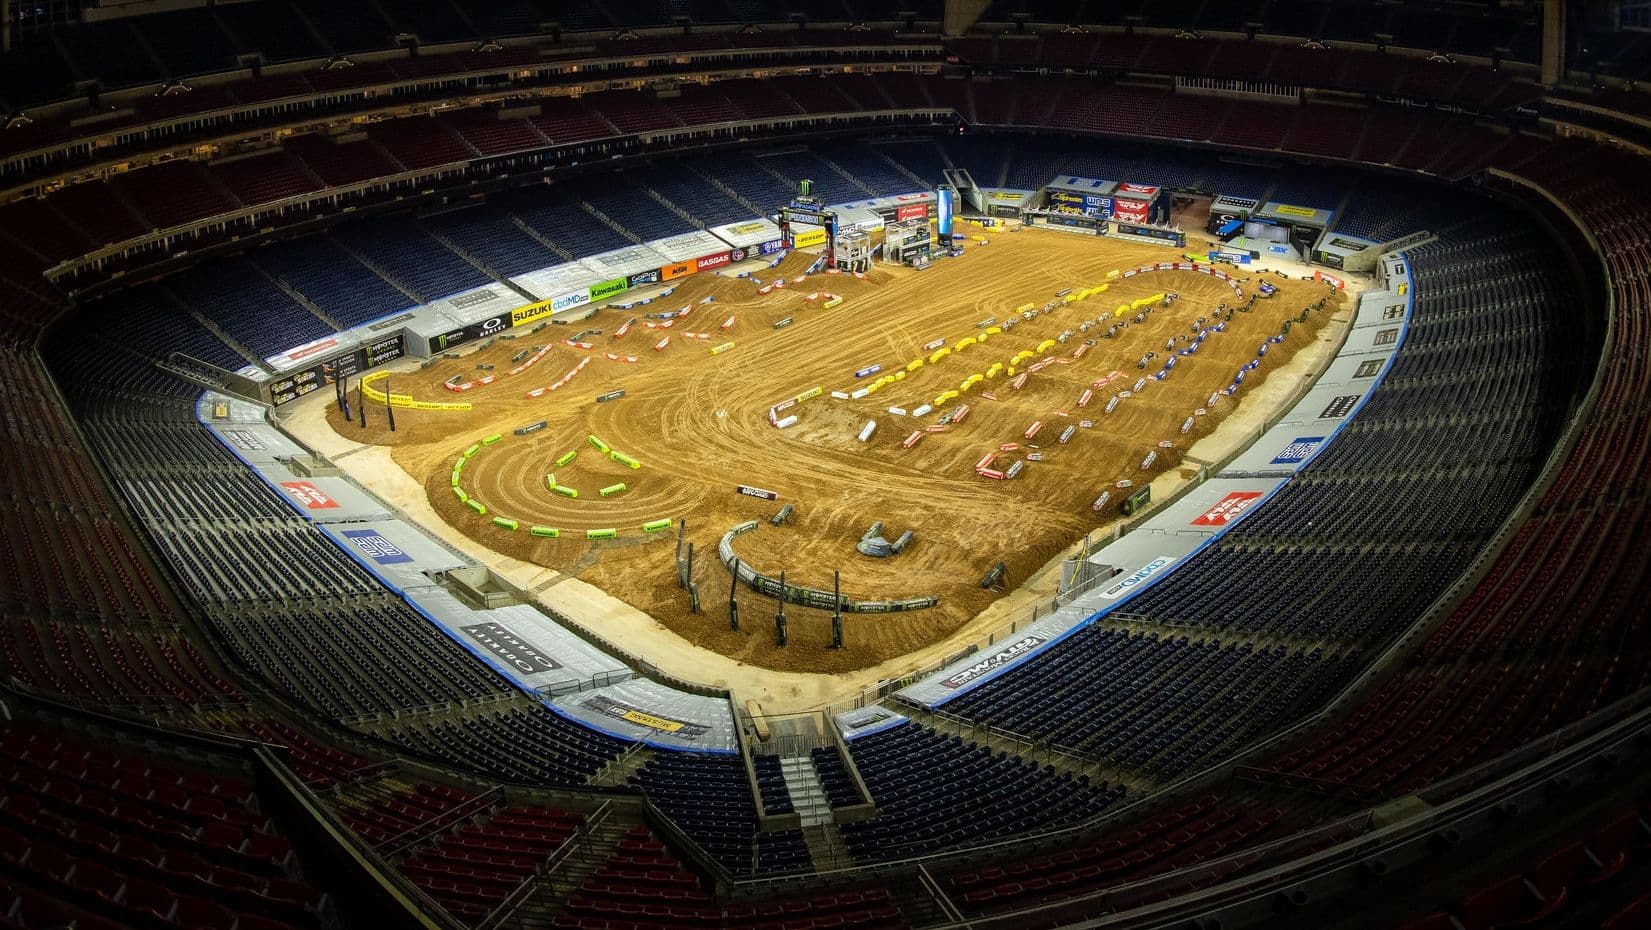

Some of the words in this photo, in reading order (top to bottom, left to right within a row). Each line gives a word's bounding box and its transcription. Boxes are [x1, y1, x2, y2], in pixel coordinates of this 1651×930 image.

[698, 254, 729, 268] GASGAS
[631, 271, 657, 282] GoPro
[672, 266, 688, 275] KTM
[591, 281, 626, 298] Kawasaki
[553, 294, 581, 310] cbdMD
[513, 303, 552, 322] SUZUKI
[468, 628, 517, 660] OAKLEY
[487, 624, 536, 656] OAKLEY
[629, 712, 672, 729] MUSTANG
